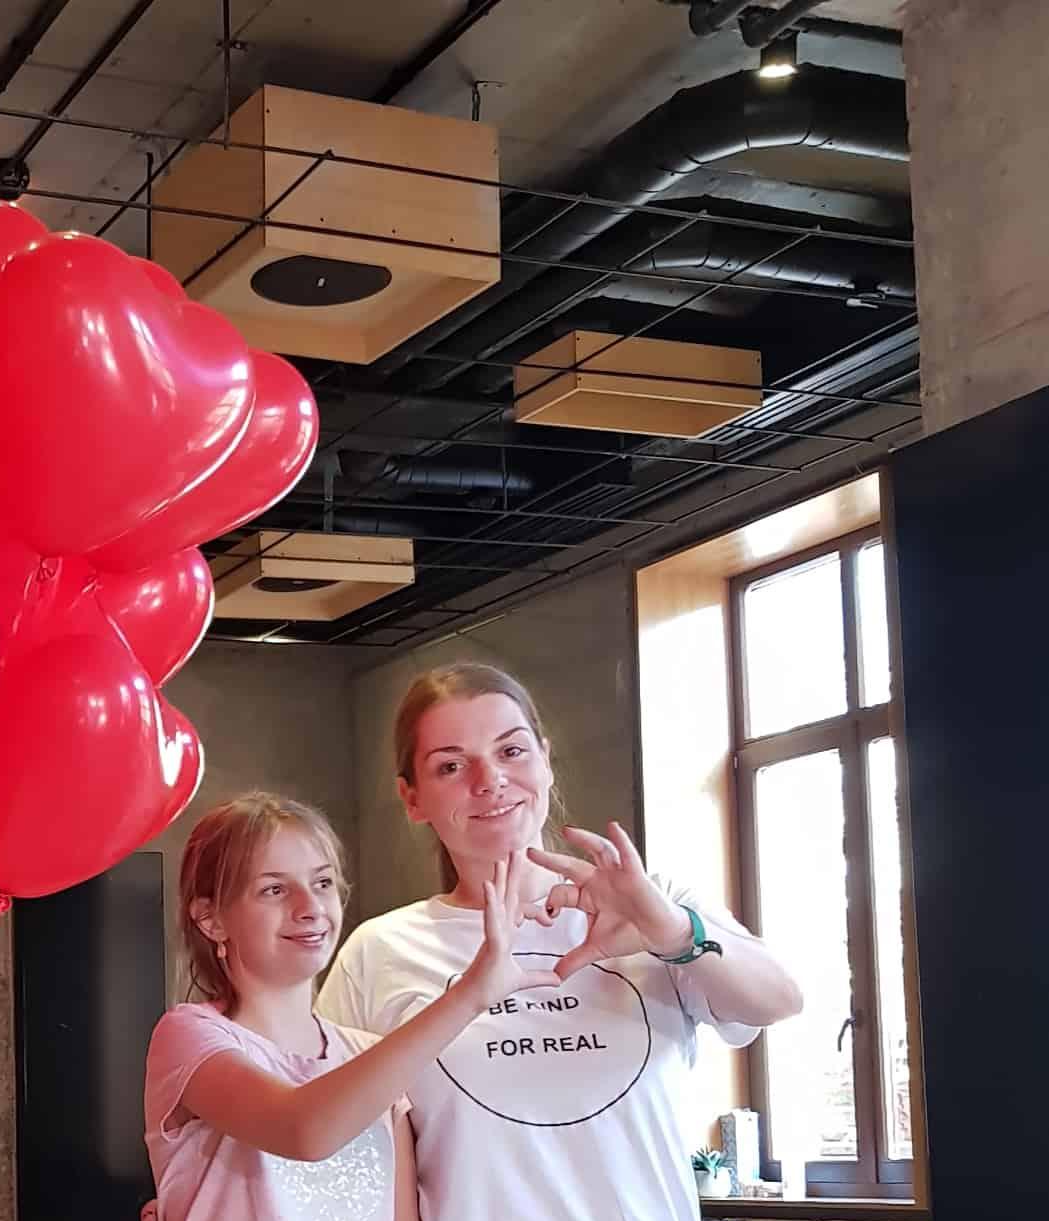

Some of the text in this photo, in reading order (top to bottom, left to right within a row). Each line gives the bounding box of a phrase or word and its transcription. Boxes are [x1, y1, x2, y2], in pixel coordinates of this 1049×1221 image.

[488, 998, 519, 1015] BE
[486, 1033, 607, 1058] FOR REAL
